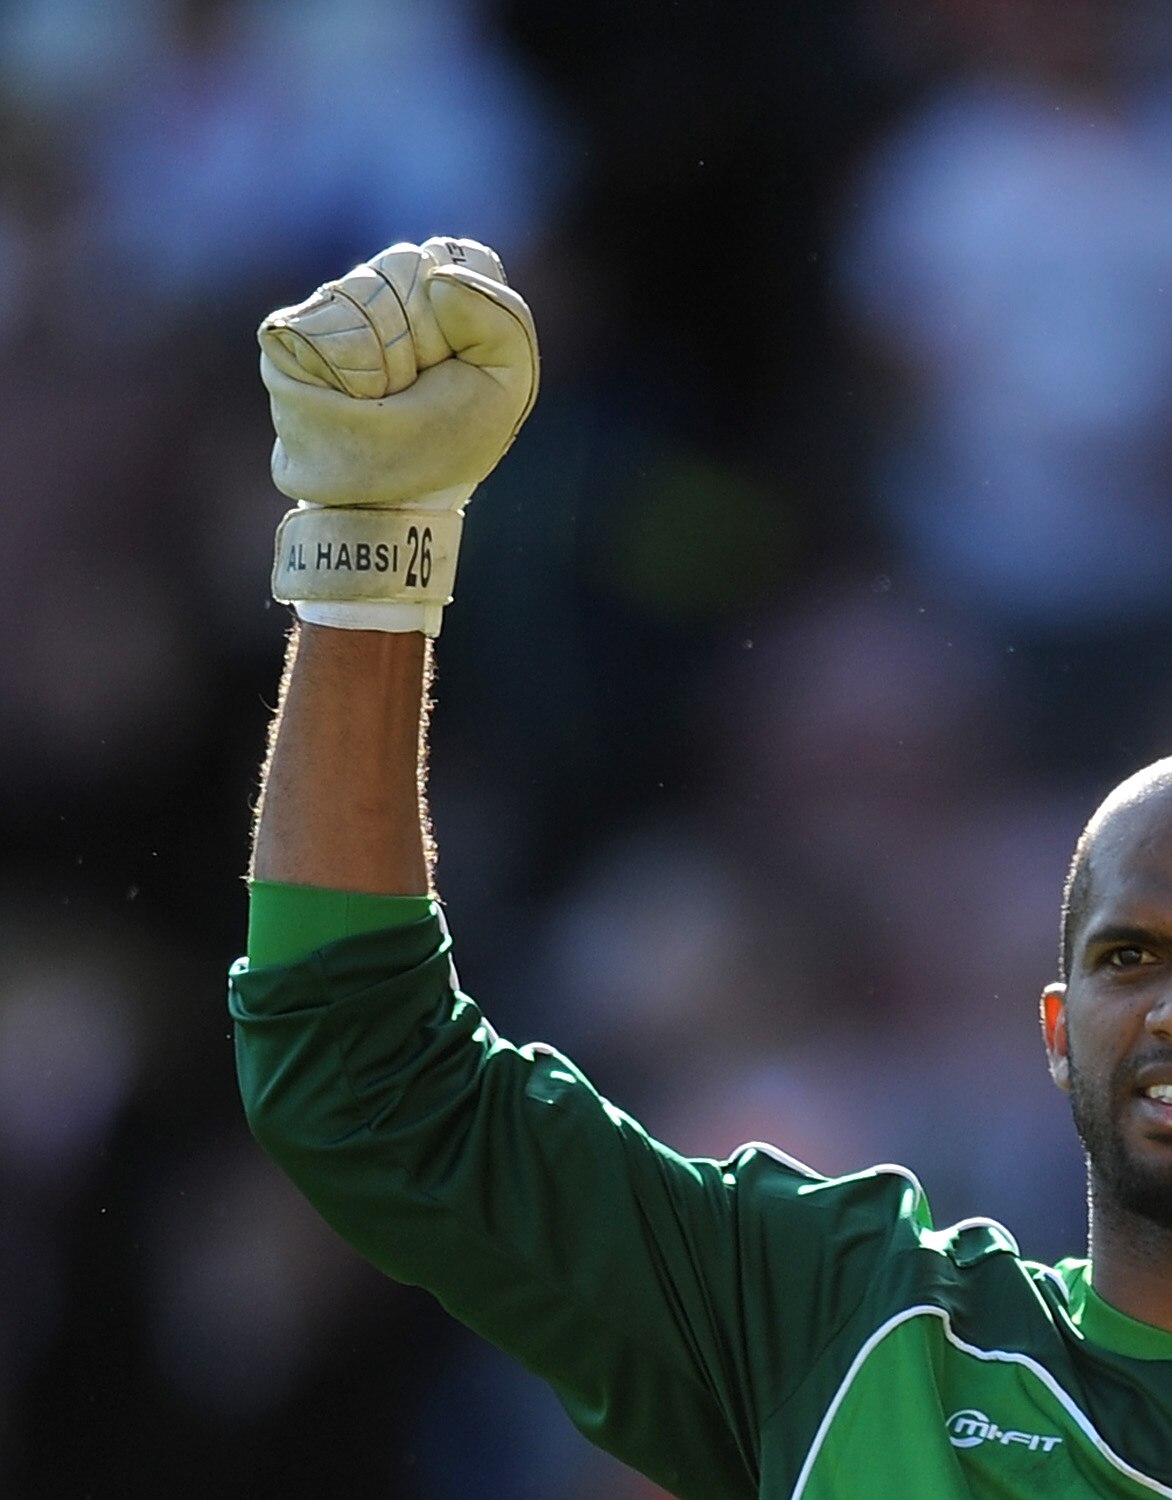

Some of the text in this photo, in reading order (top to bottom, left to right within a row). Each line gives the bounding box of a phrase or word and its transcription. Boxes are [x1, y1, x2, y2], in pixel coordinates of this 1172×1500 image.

[286, 526, 433, 589] AL HABSI 26
